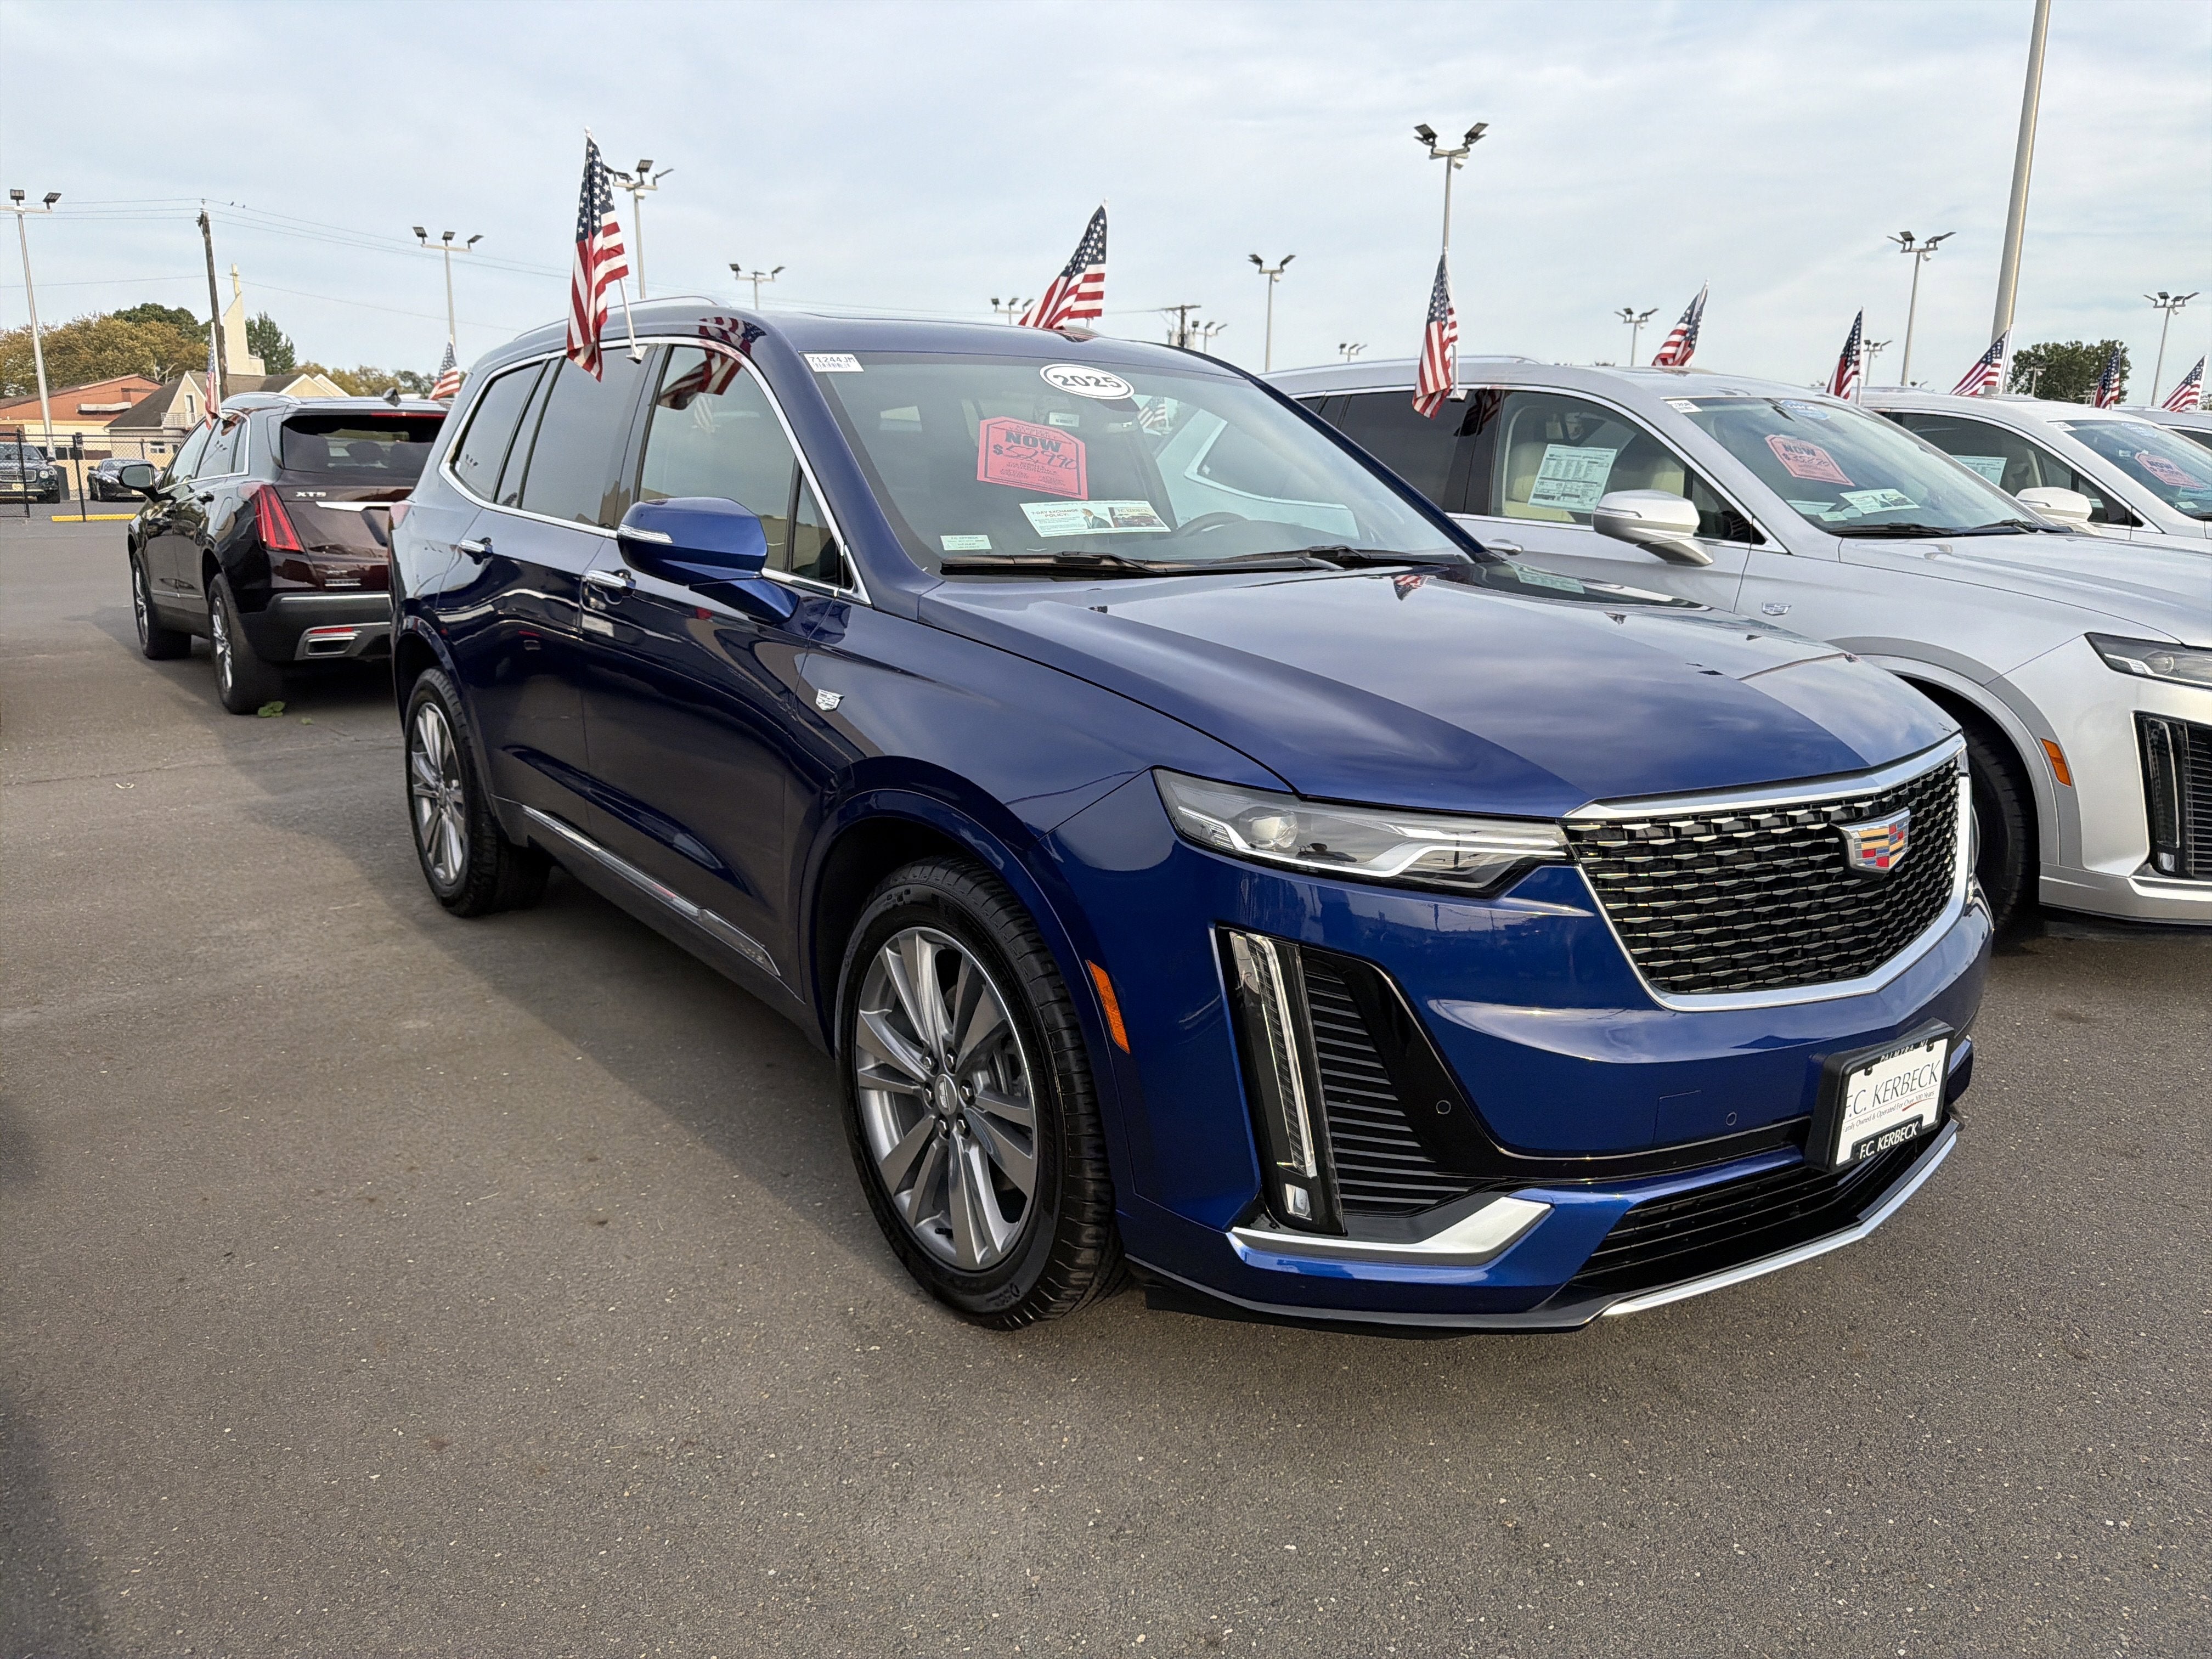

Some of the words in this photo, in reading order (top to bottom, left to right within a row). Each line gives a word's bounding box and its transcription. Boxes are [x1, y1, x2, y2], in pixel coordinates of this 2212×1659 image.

[1053, 375, 1122, 388] 2025
[1005, 431, 1062, 453] NOW
[1782, 444, 1816, 456] NOW
[1880, 1044, 1914, 1063] PALMYRA
[1872, 1060, 1940, 1107] KERBECK
[1856, 1114, 1872, 1127] Owned
[1876, 1103, 1896, 1120] Operated
[1904, 1098, 1914, 1106] Over
[1859, 1141, 1875, 1159] F.C.
[1877, 1121, 1918, 1152] KERBECK
